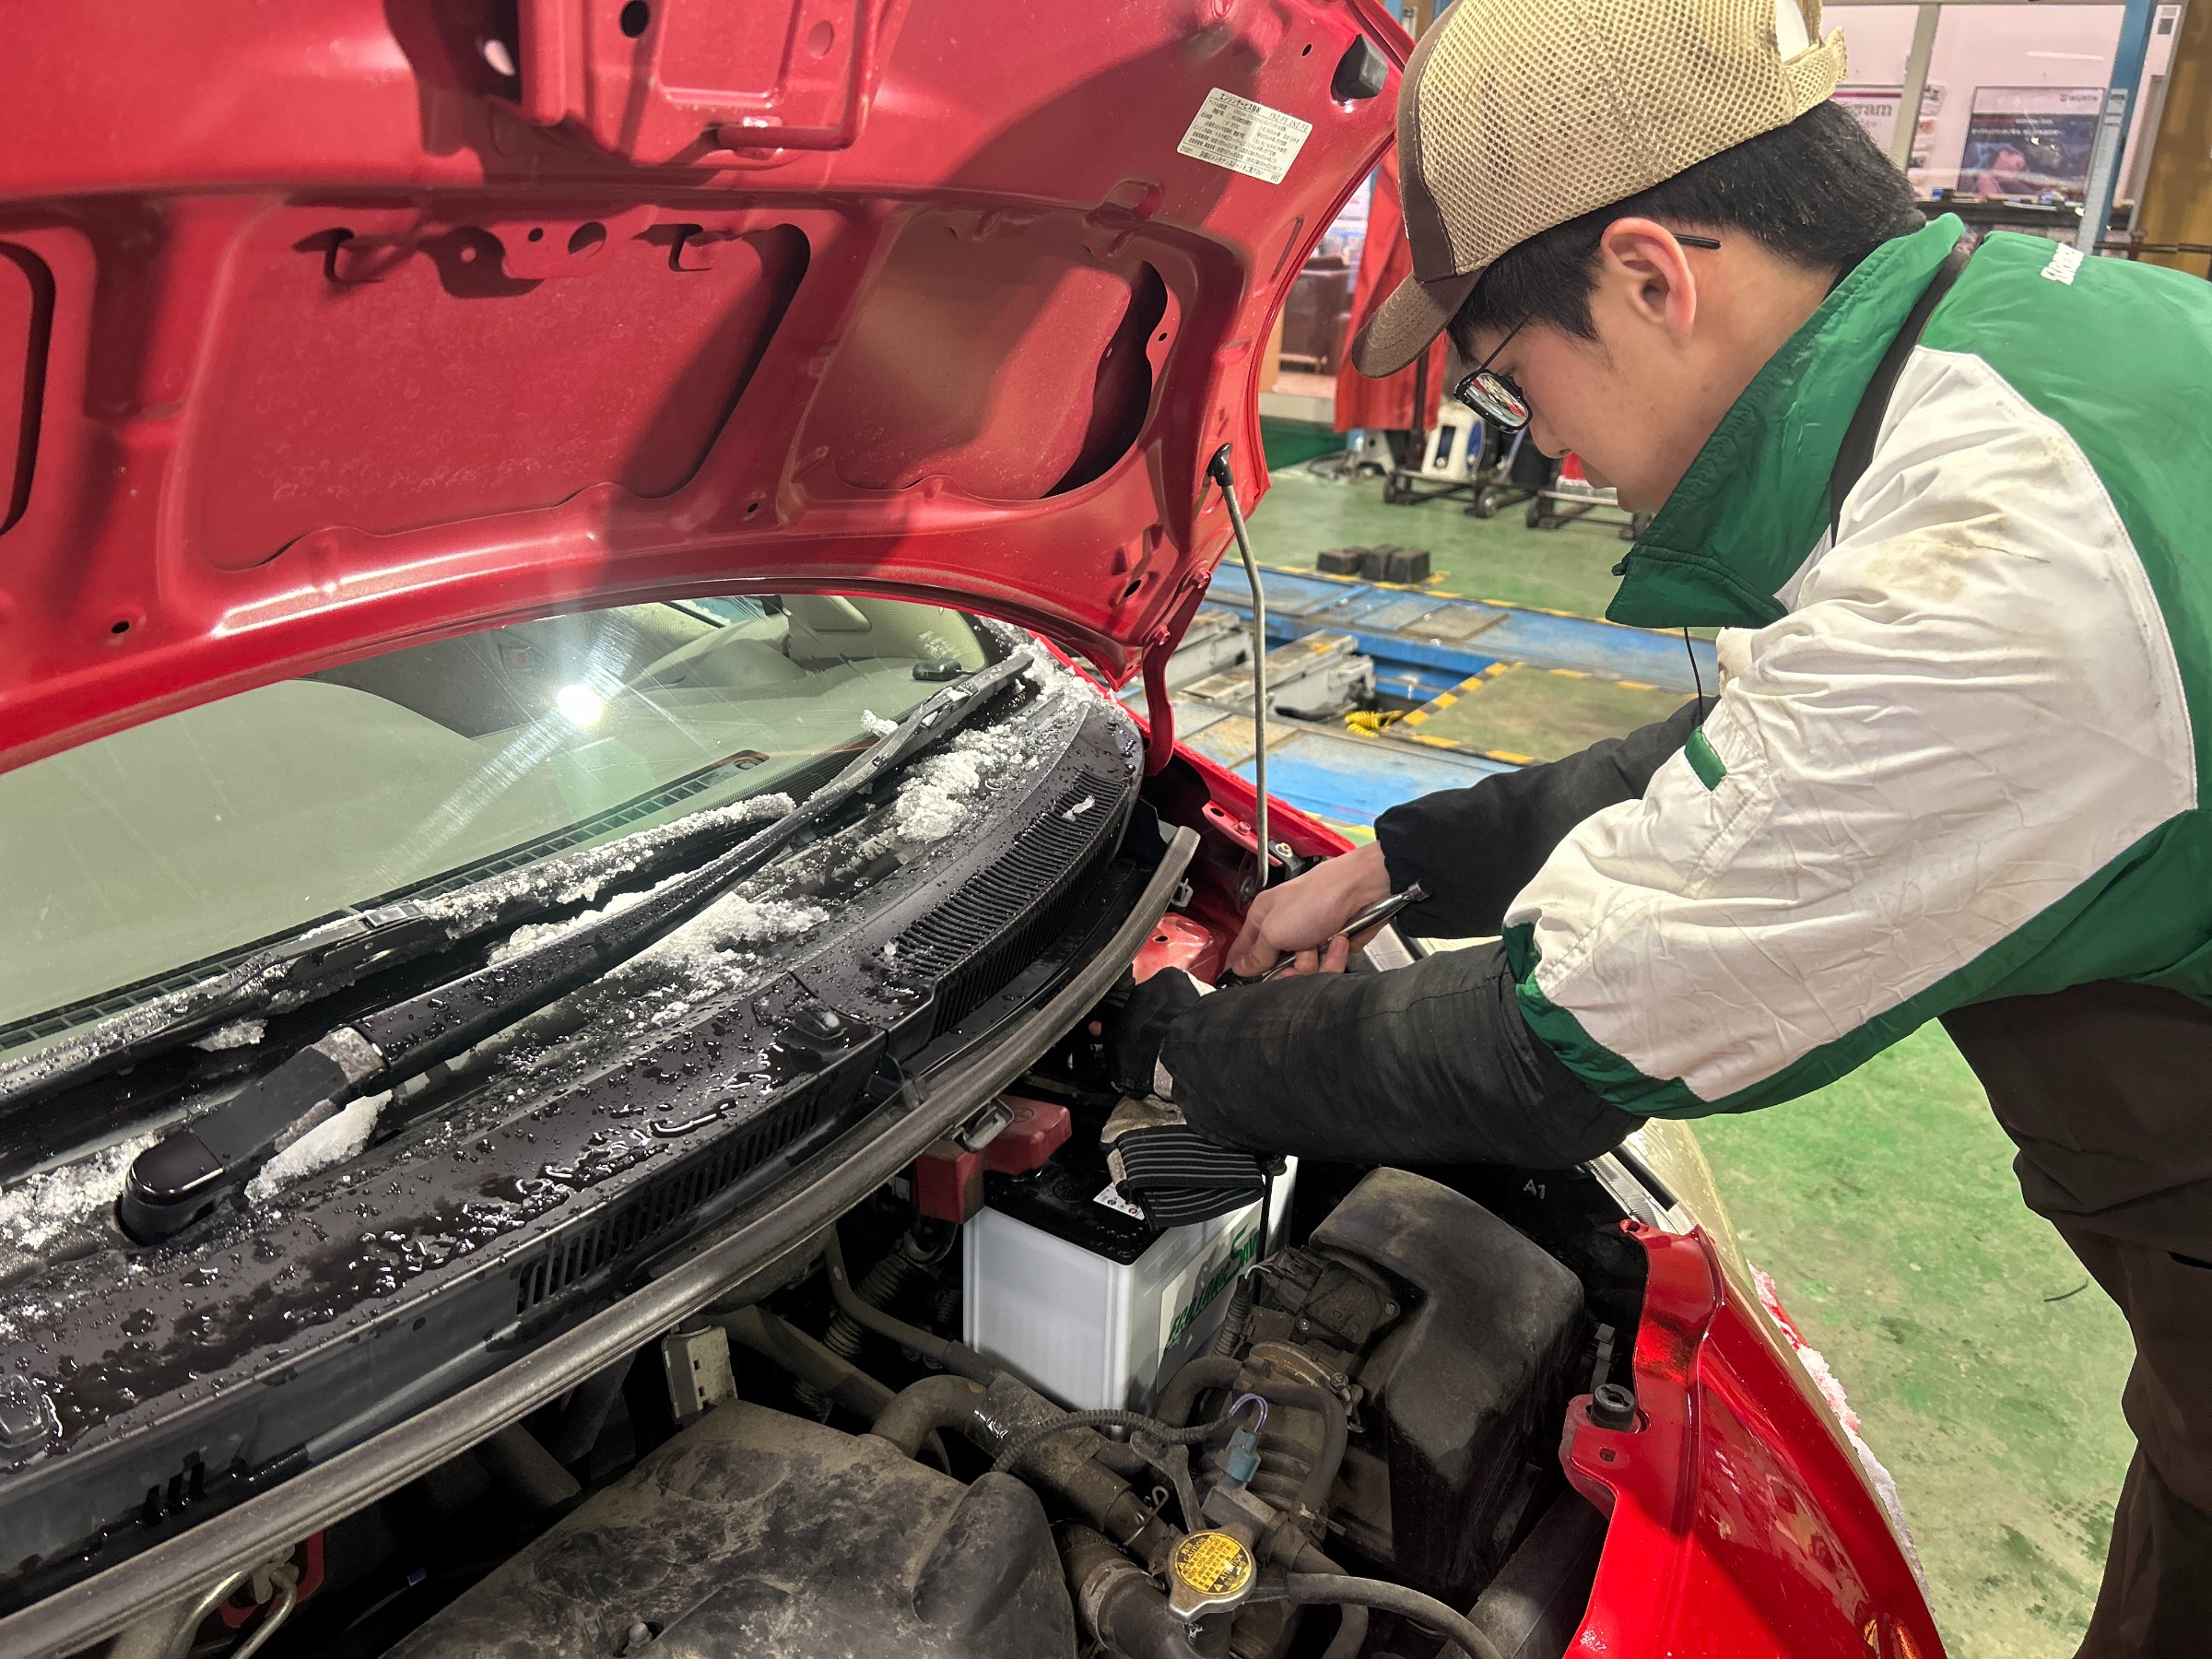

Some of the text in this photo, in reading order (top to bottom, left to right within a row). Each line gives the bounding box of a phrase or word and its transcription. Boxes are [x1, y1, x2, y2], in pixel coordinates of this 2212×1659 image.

[1523, 1179, 1546, 1199] A1
[1183, 1536, 1206, 1562] CAUTION
[1219, 1553, 1243, 1582] ATTTION
